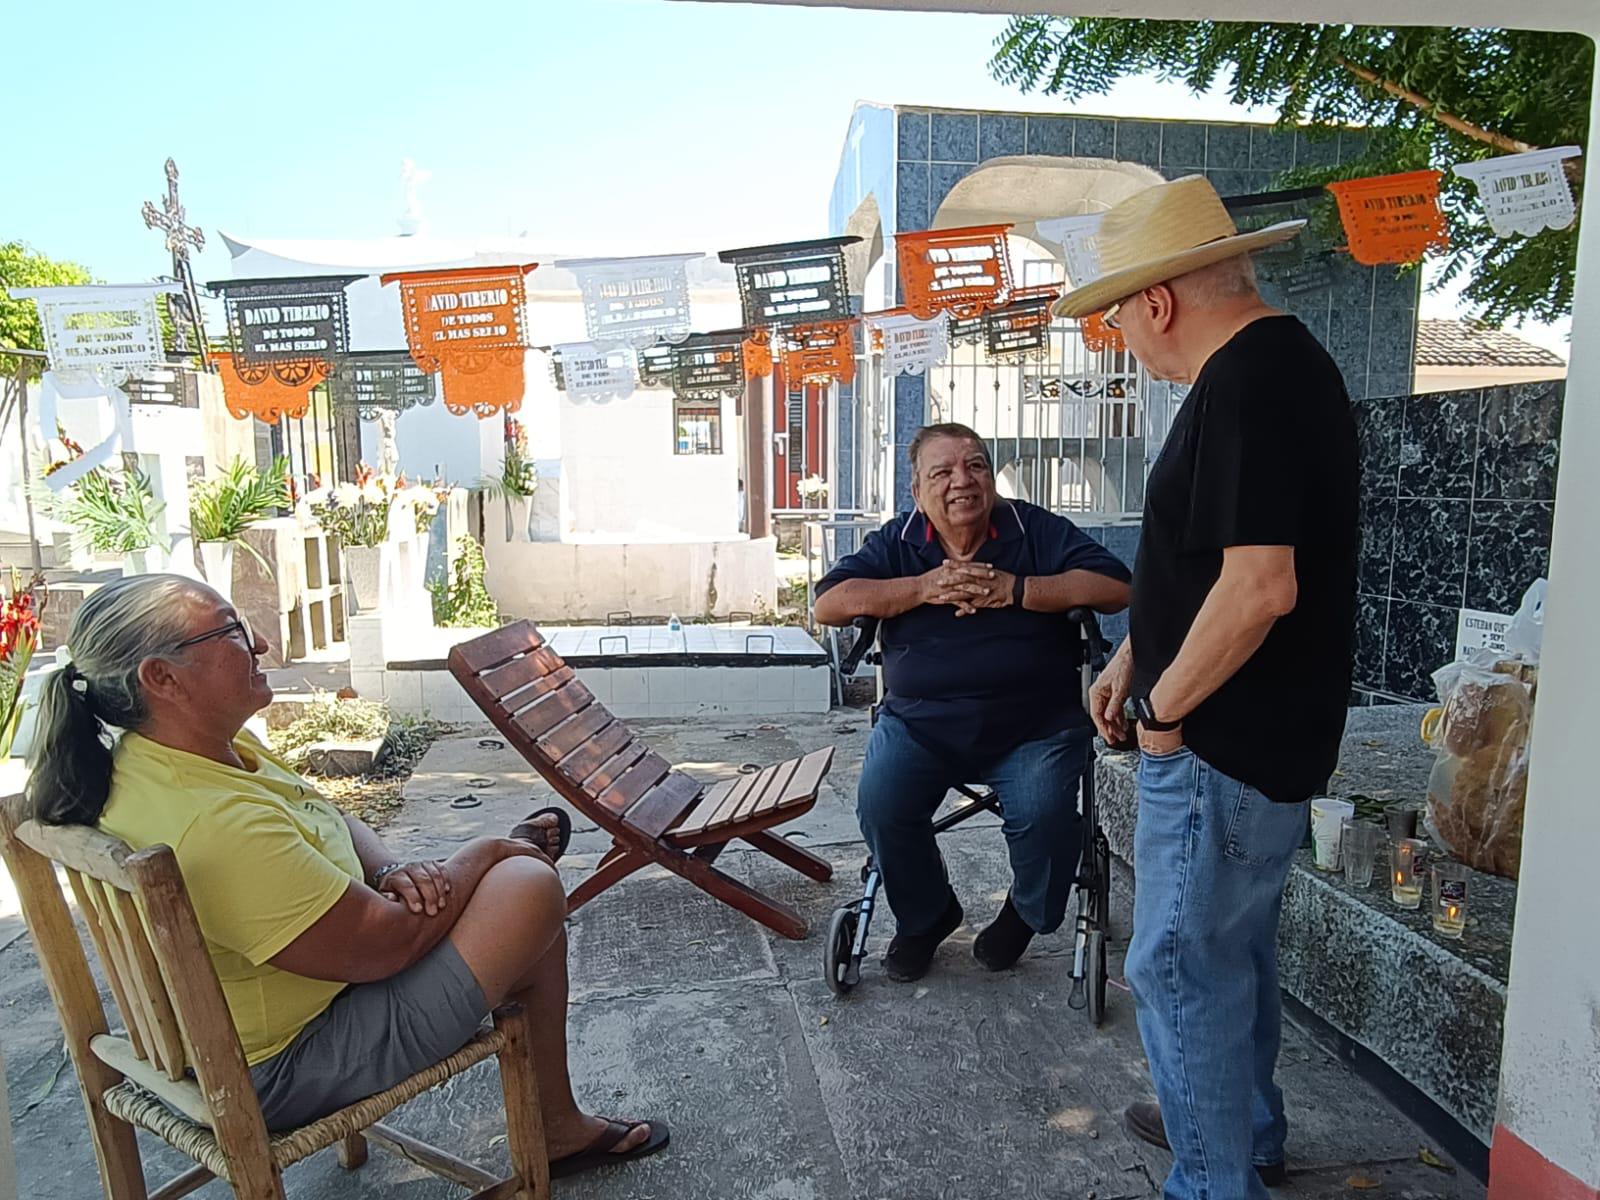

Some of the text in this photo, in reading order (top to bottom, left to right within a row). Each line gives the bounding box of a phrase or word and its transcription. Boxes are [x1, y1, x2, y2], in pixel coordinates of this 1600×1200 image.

[424, 288, 509, 312] DAVID TIBERIO
[244, 304, 330, 326] DAVID TIBERIO
[441, 312, 494, 327] DE TODOS
[262, 326, 316, 340] DE TODOS
[432, 331, 447, 341] EL
[448, 328, 471, 340] MAS
[269, 341, 293, 352] MAS
[294, 339, 329, 351] SERIO
